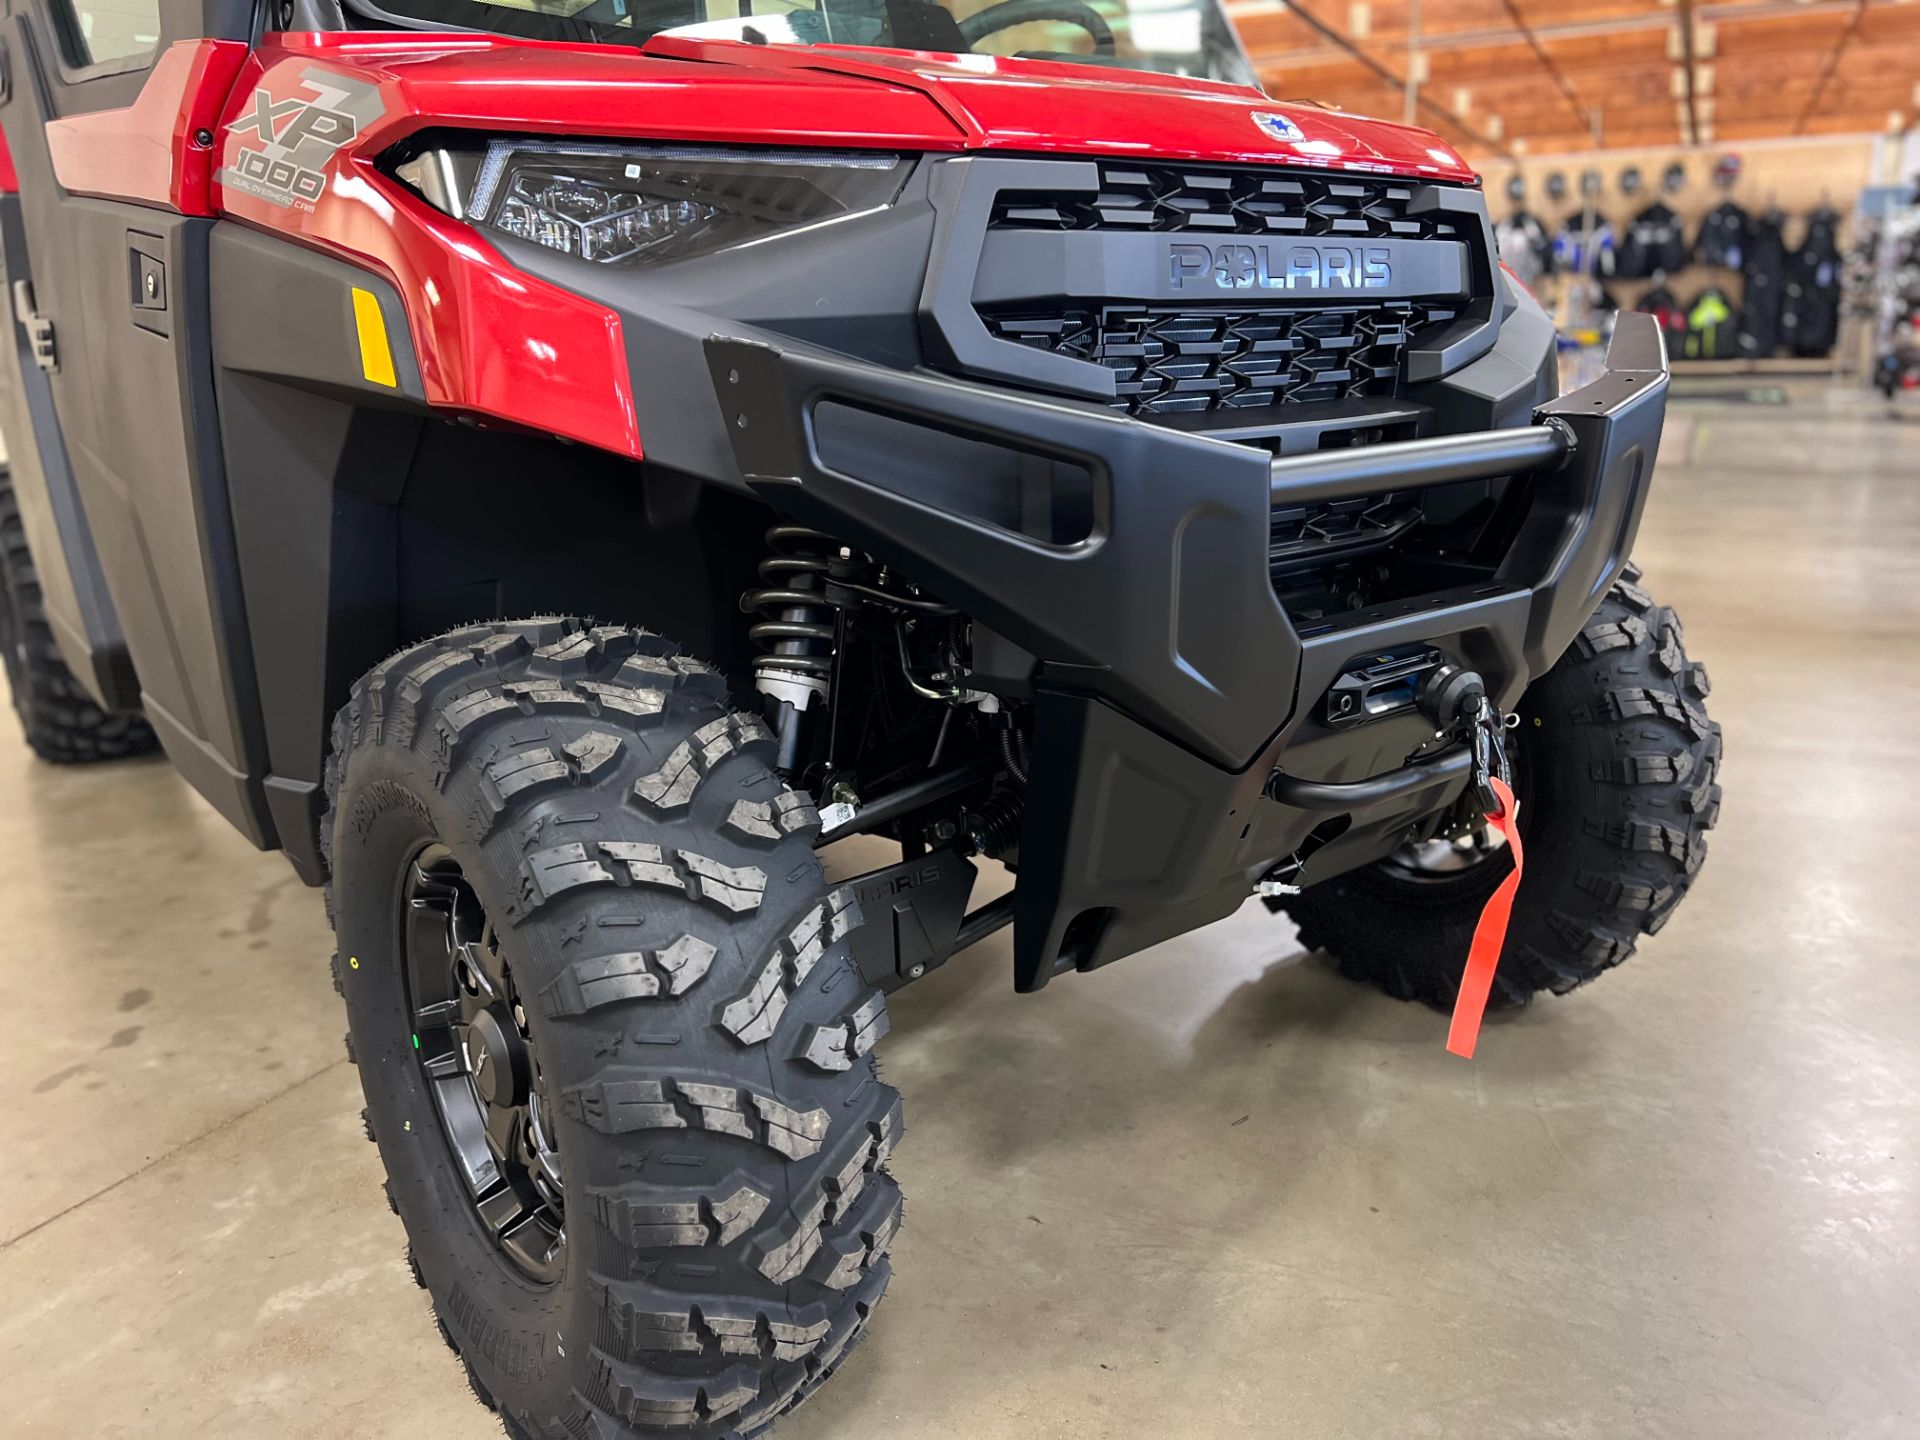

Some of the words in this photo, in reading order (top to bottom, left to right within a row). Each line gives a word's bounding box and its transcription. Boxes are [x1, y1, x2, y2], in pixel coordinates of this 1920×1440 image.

[223, 88, 357, 152] XP
[228, 147, 327, 203] 1000
[252, 184, 294, 206] OVERHEAD
[294, 200, 316, 214] CAM
[1169, 243, 1393, 289] POLARIS
[856, 863, 943, 906] LARIS
